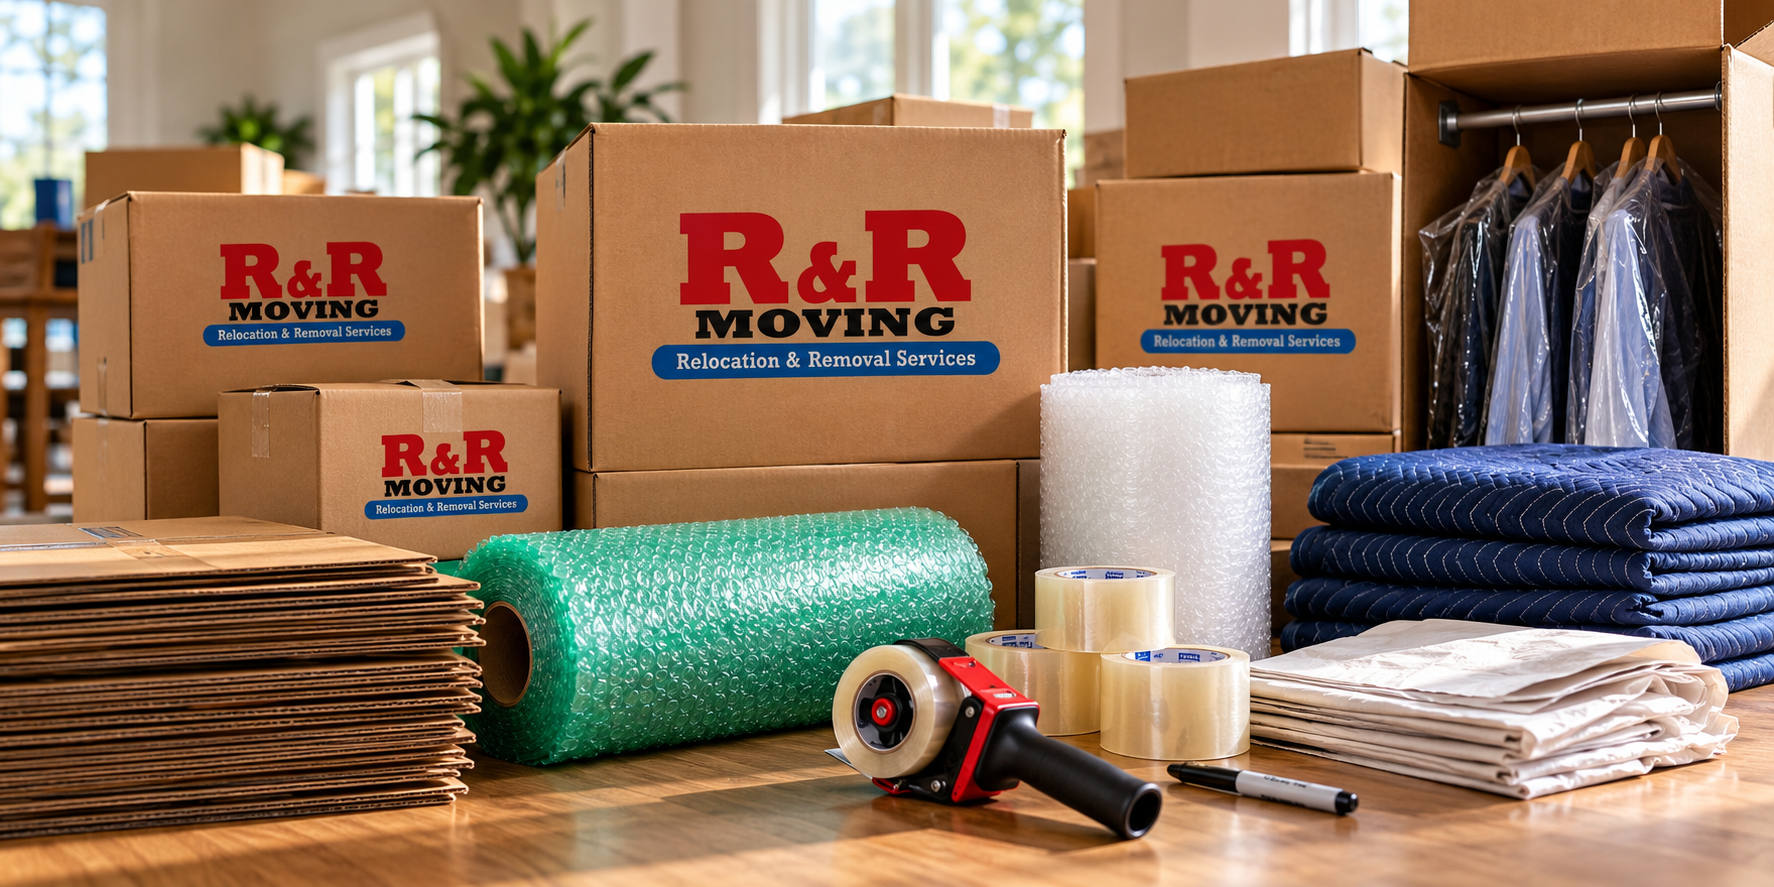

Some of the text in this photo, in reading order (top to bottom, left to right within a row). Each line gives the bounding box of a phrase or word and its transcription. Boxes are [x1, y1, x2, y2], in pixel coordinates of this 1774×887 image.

[680, 209, 971, 305] R&R
[220, 241, 387, 300] R&R
[1161, 238, 1330, 301] R&R
[228, 299, 379, 321] MOVING
[1163, 302, 1328, 326] MOVING
[217, 325, 392, 341] Relocation & Removal Services
[695, 306, 955, 339] MOVING
[1153, 334, 1341, 348] Relocation & Removal Services
[676, 349, 976, 370] Relocation & Removal Services
[381, 430, 508, 478] R&R
[384, 475, 506, 497] MOVING
[375, 499, 517, 515] Relocation & Removal Services
